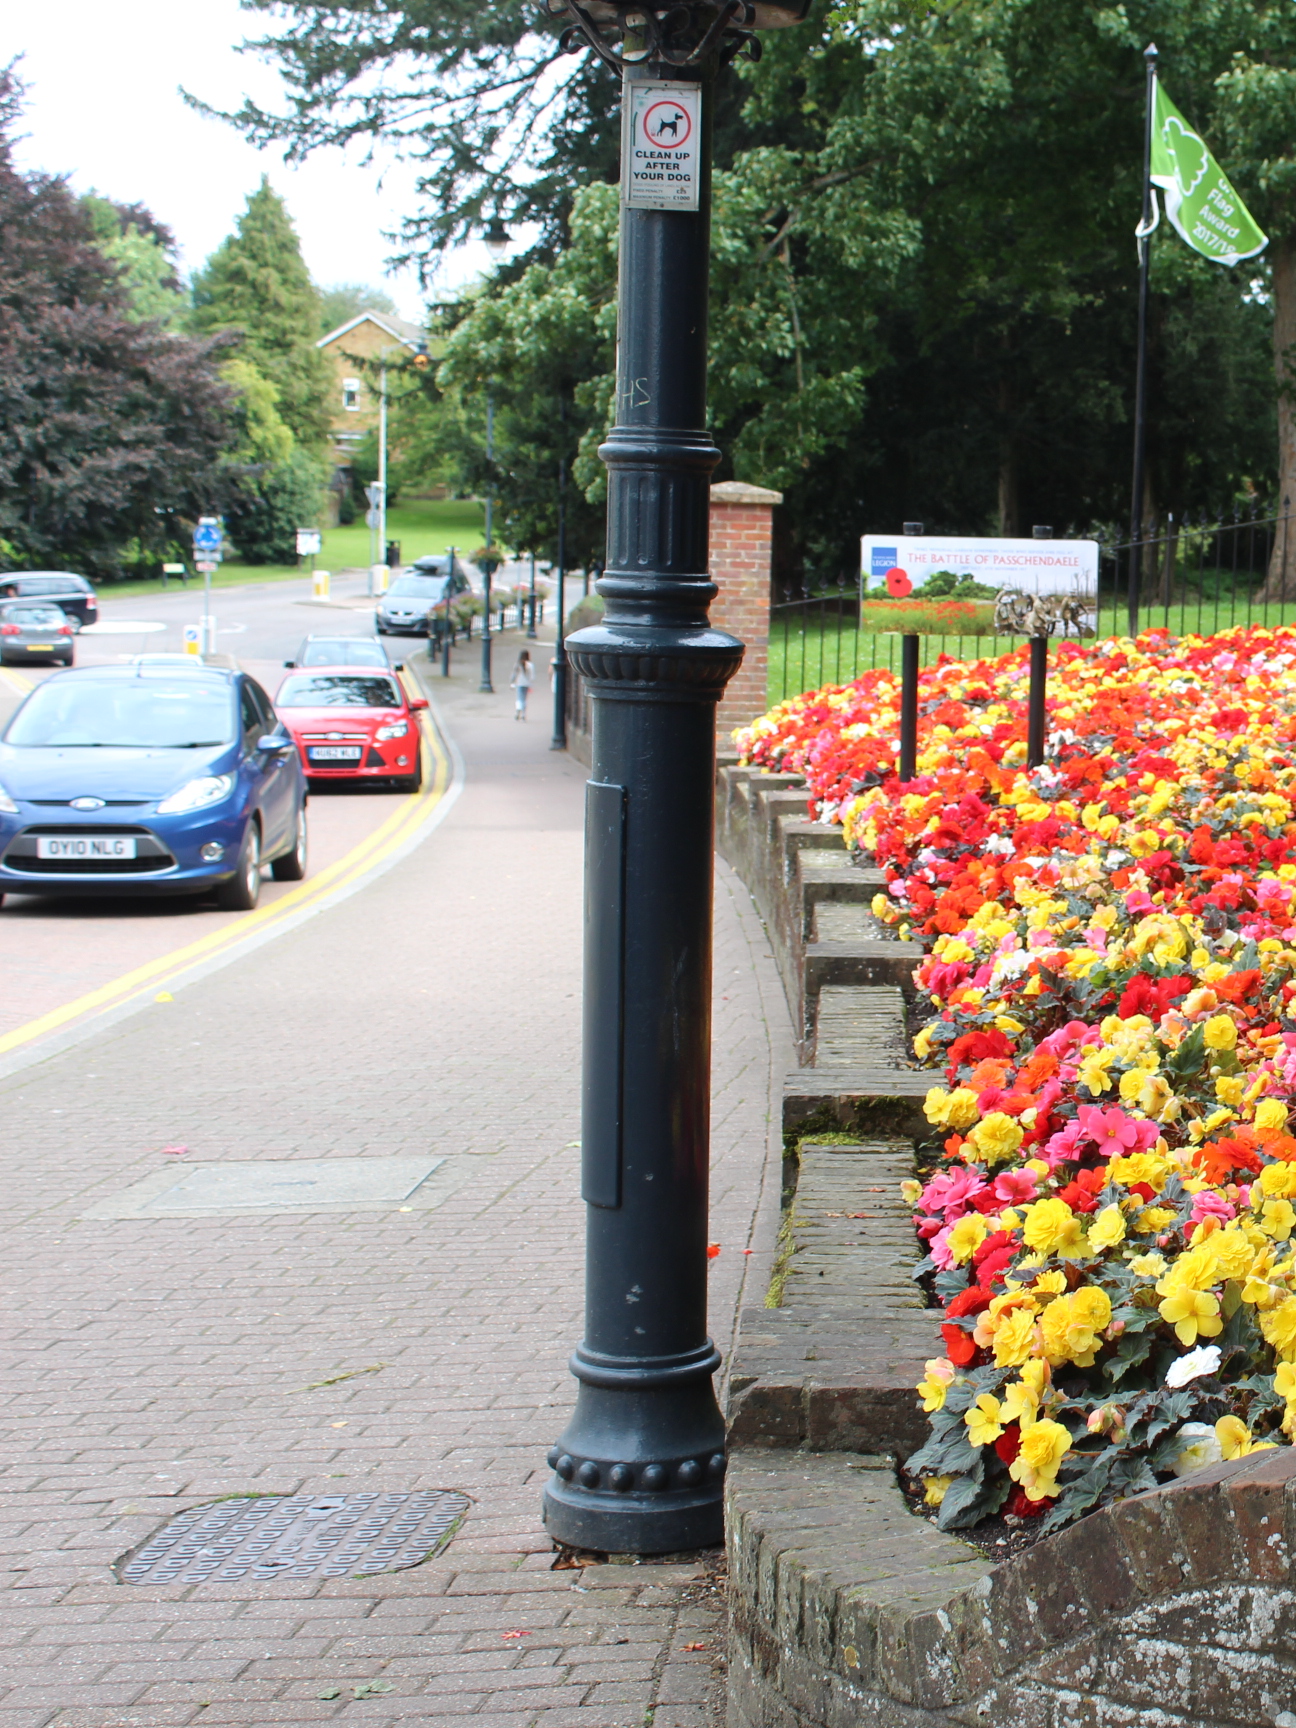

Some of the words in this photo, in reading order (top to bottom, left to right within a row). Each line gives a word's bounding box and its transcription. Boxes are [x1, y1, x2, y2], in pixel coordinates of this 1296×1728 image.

[635, 151, 672, 159] CLEAN
[675, 152, 690, 160] UP
[645, 161, 680, 170] AFTER
[633, 172, 664, 181] YOUR
[667, 173, 691, 182] DOG
[1206, 188, 1235, 217] Flag
[1199, 204, 1241, 239] Award
[872, 559, 896, 567] LEGION
[907, 552, 928, 563] THE
[930, 553, 970, 565] BATTLE
[974, 554, 990, 565] OF
[993, 555, 1079, 567] PASSCHENDAELE
[48, 840, 87, 855] OY10
[92, 840, 125, 855] NLG
